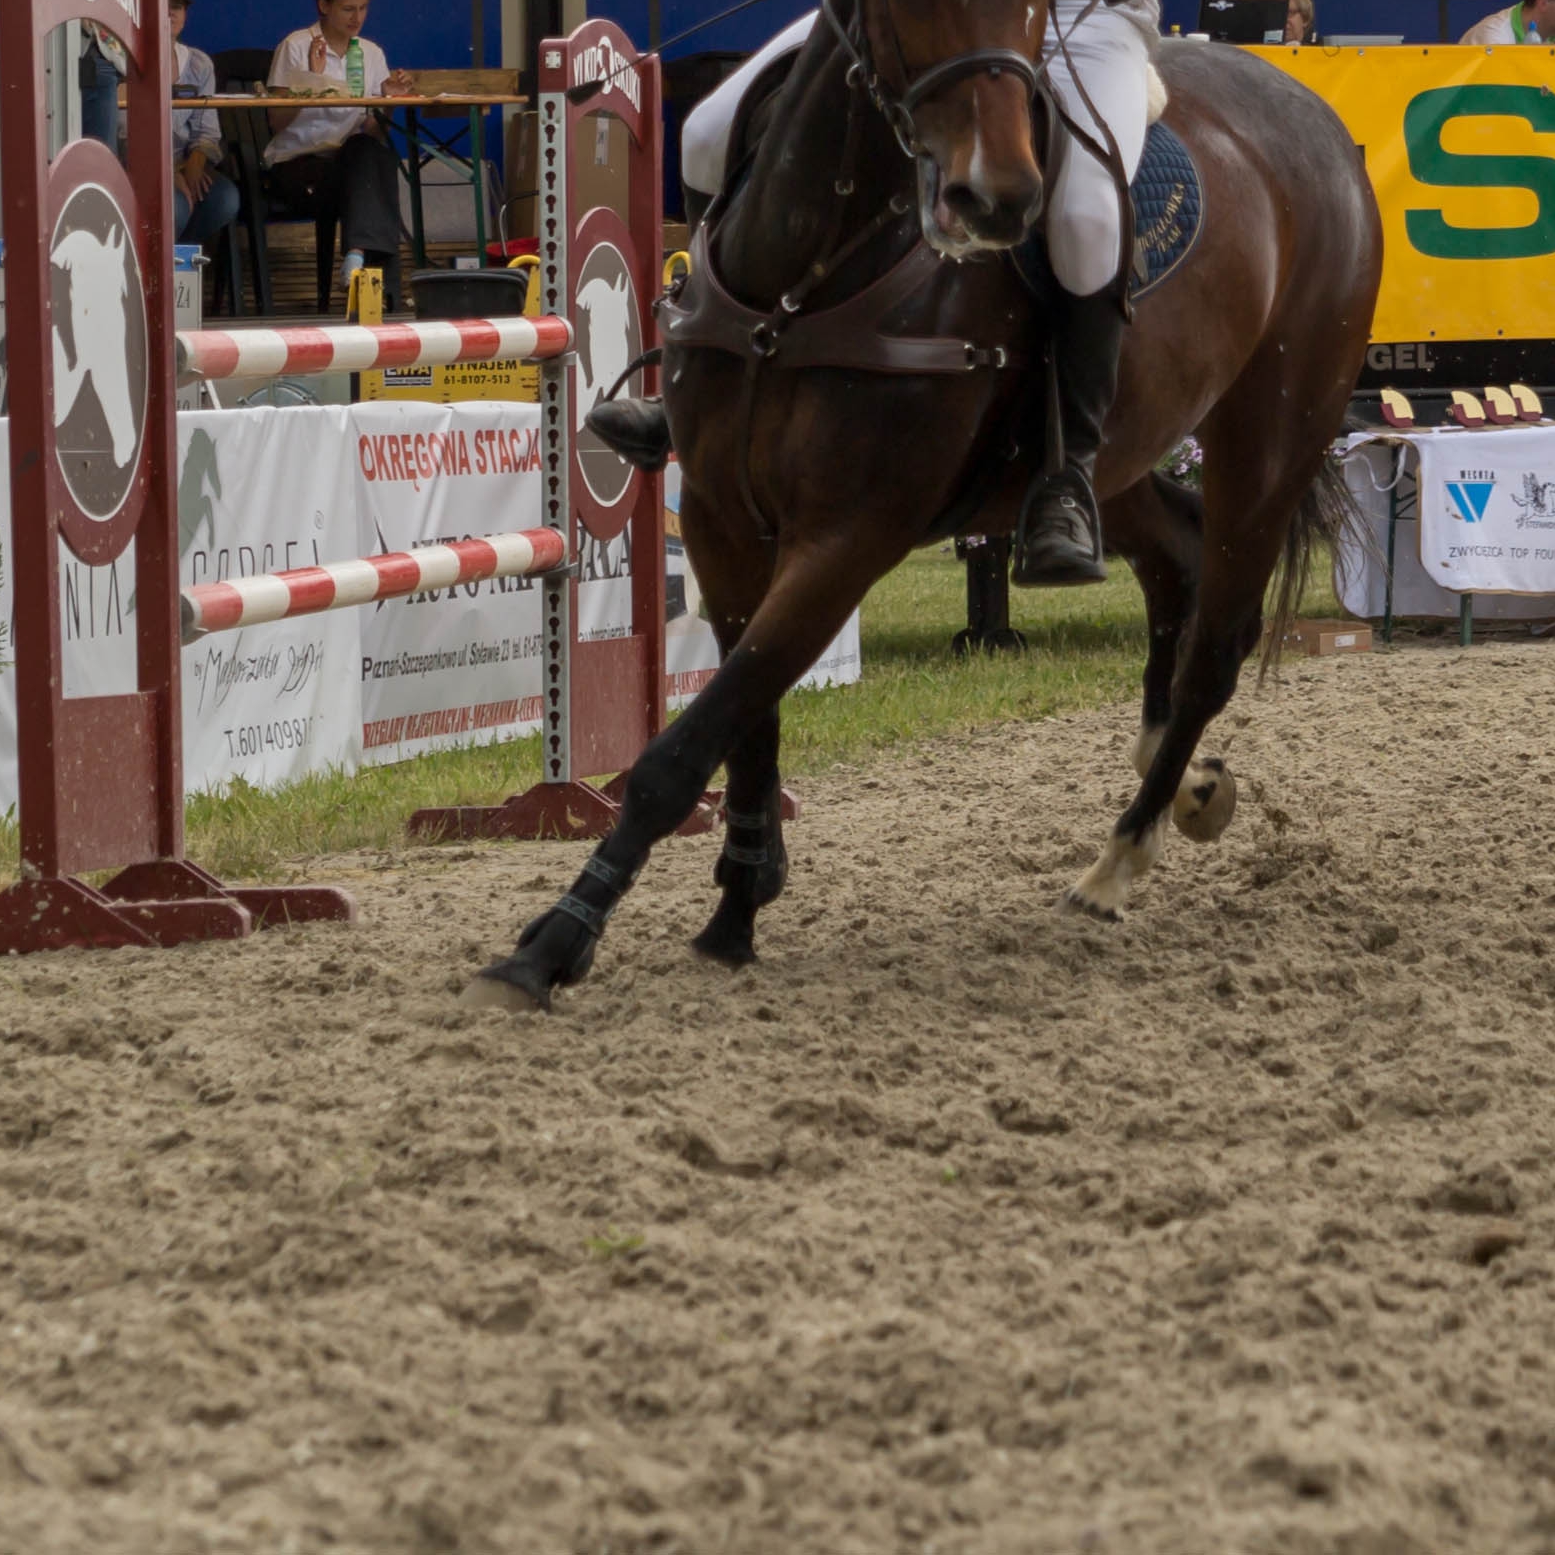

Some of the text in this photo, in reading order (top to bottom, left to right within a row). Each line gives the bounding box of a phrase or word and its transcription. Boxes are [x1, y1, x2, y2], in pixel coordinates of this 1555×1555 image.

[444, 374, 511, 385] 61-8107-513
[358, 428, 543, 492] OKRĘGOWA STACJA
[1510, 547, 1528, 559] TOP
